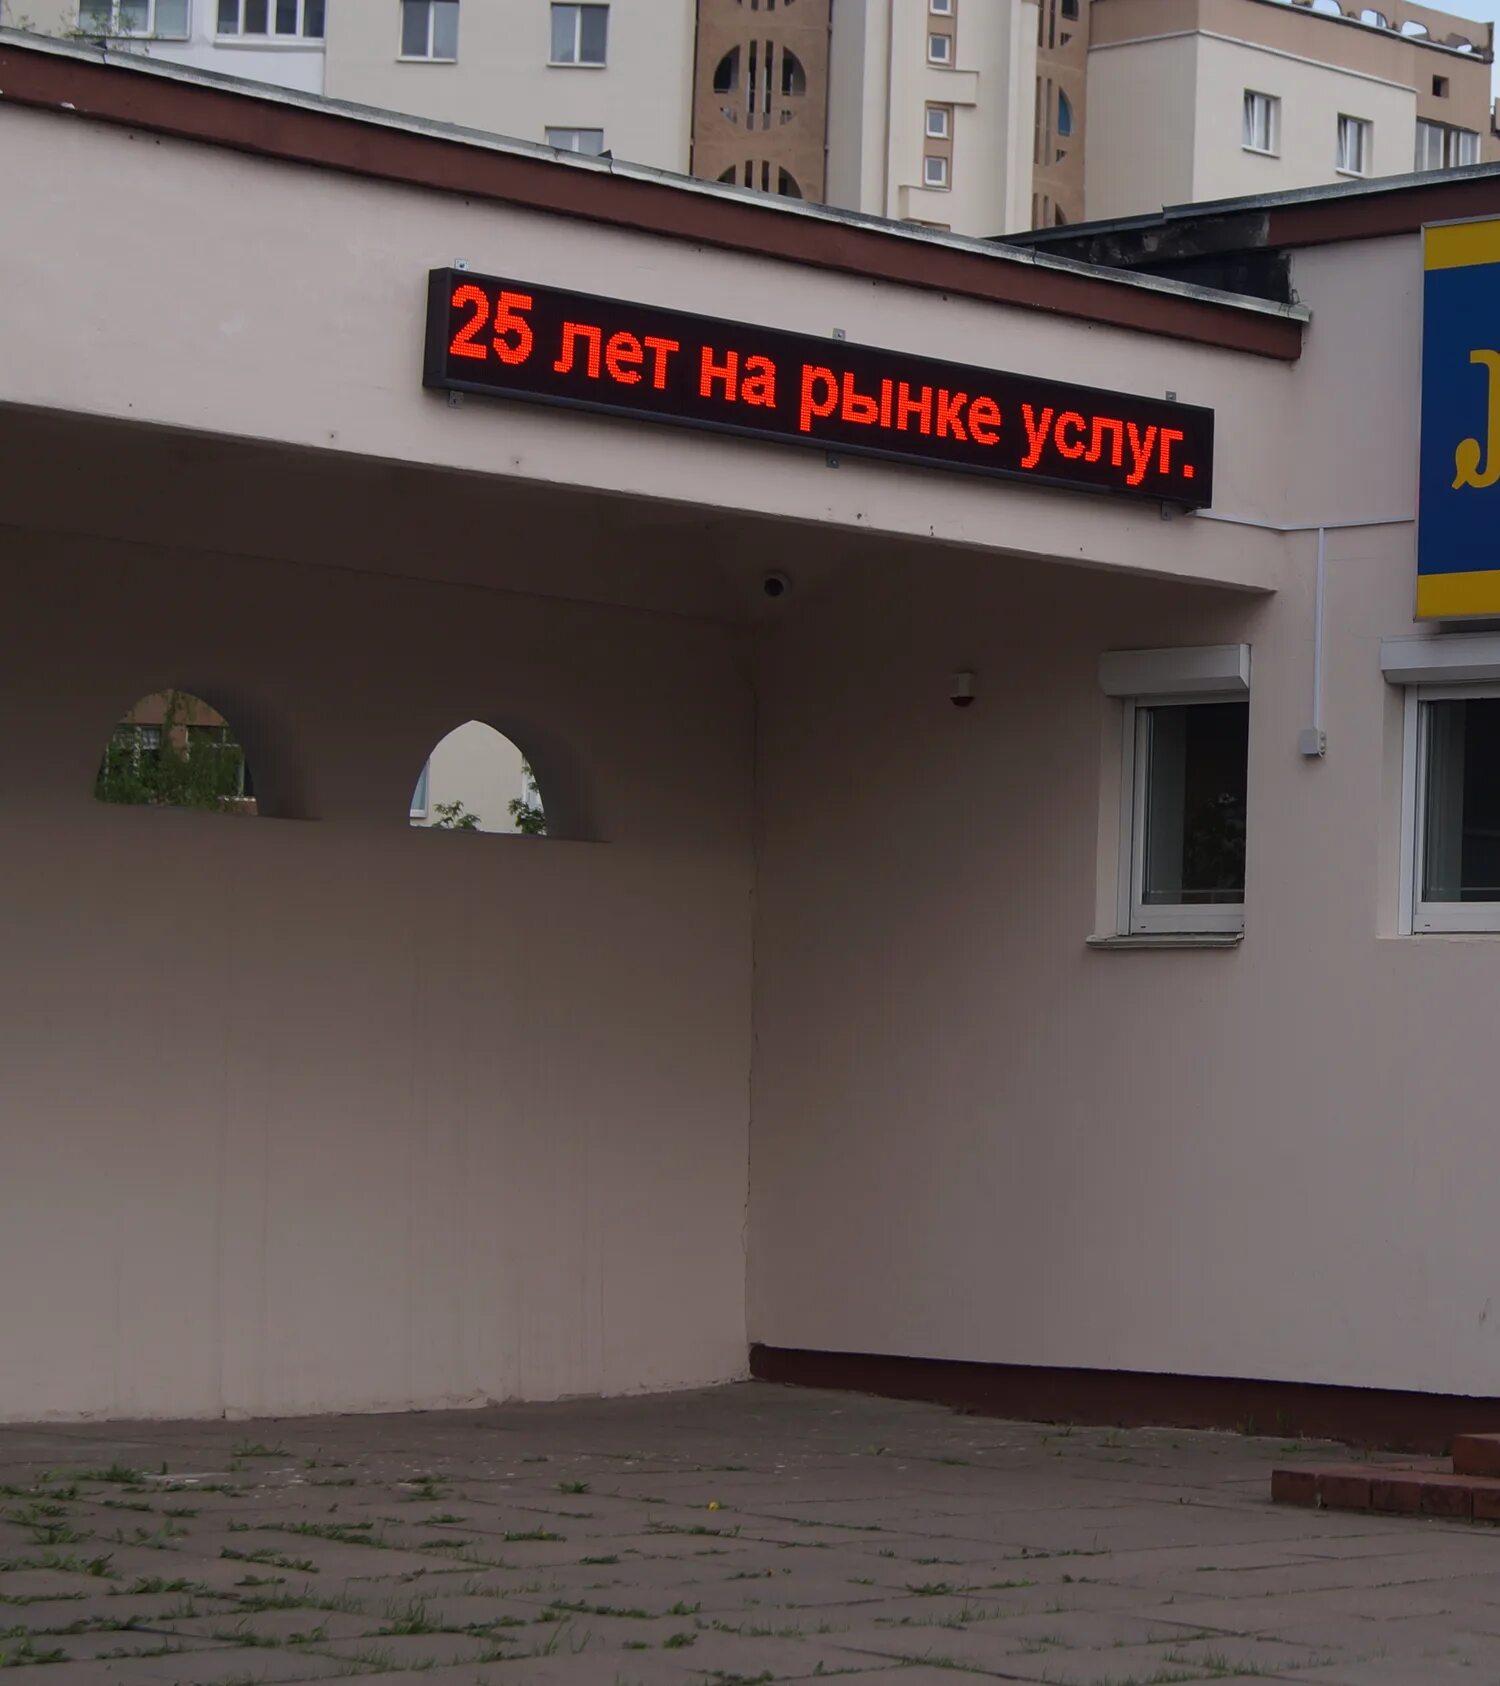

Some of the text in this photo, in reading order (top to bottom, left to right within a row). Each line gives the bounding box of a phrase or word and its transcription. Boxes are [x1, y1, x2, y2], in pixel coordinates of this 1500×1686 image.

[449, 284, 1195, 486] 25 лет на рынке услуг.
